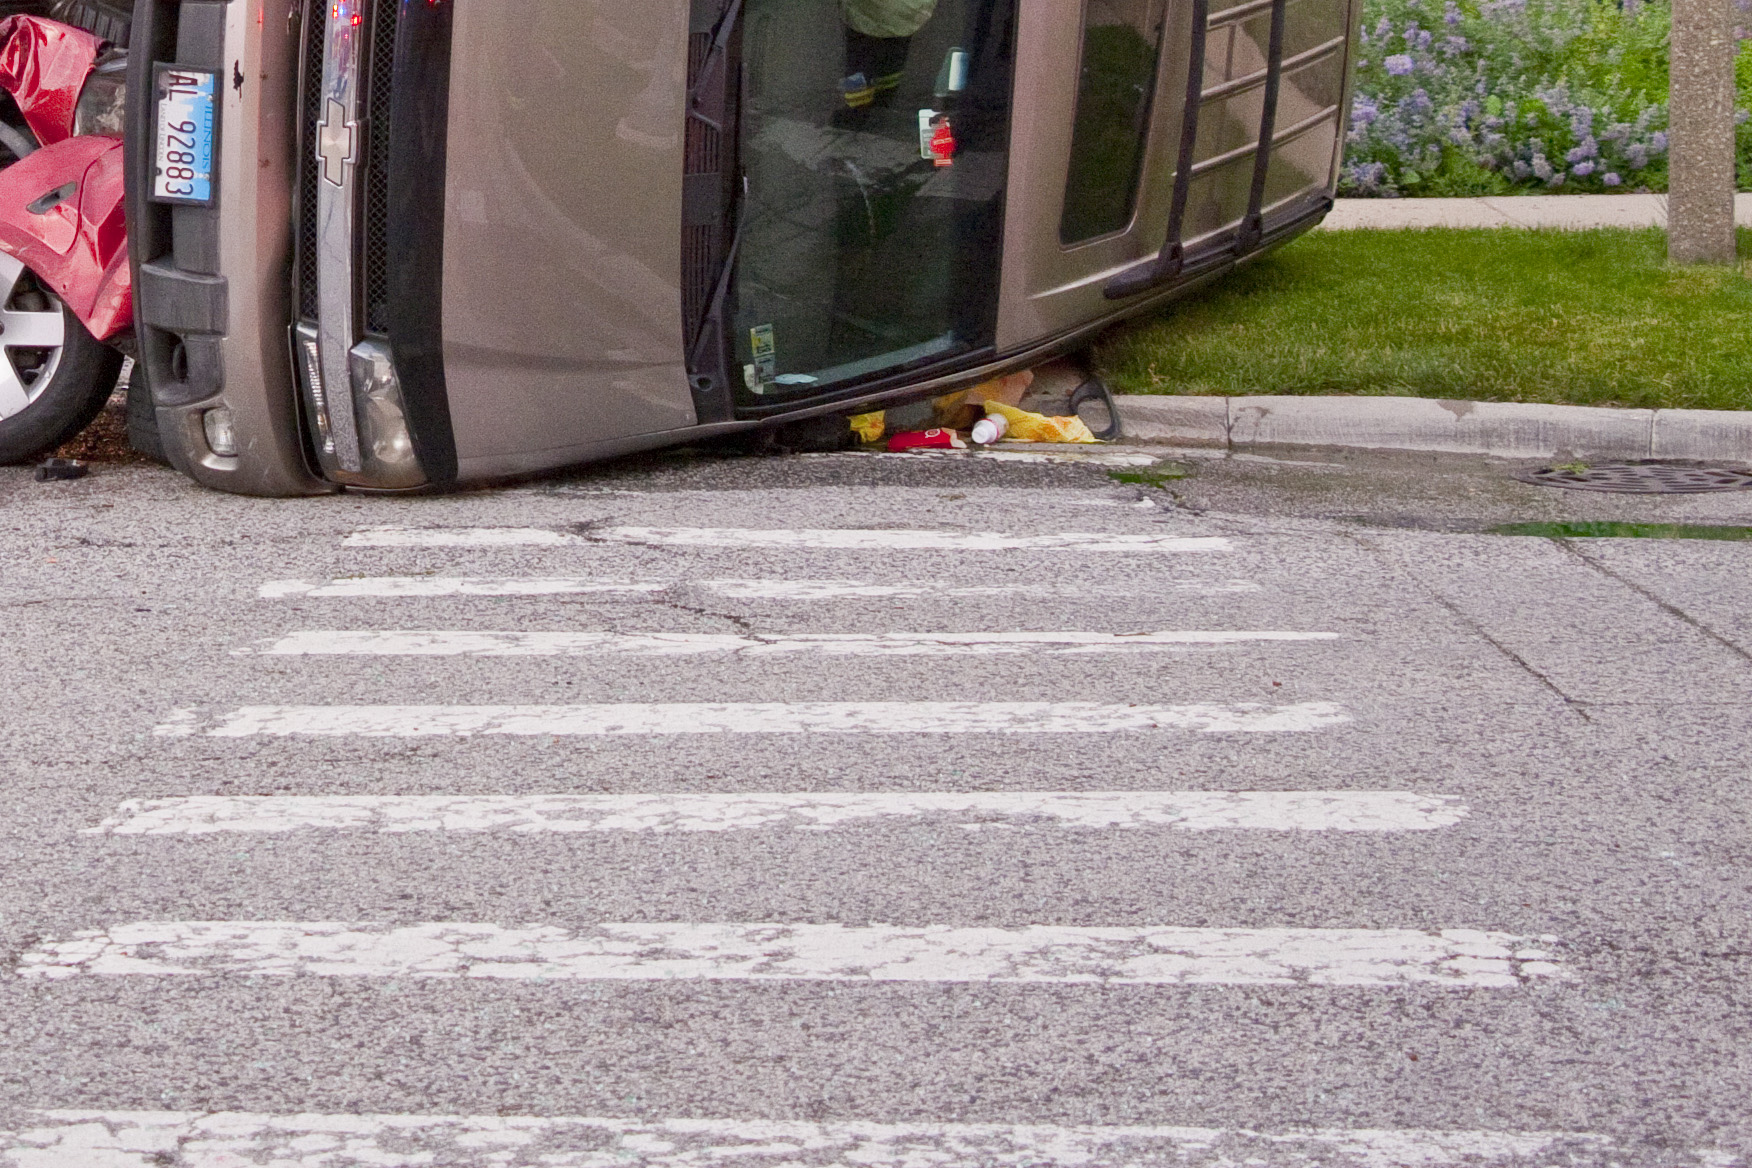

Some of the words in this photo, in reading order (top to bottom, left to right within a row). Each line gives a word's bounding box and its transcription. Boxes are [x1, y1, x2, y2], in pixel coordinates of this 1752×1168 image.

[168, 73, 198, 101] AL
[165, 120, 197, 195] 92883
[202, 105, 212, 170] ILLINOIS
